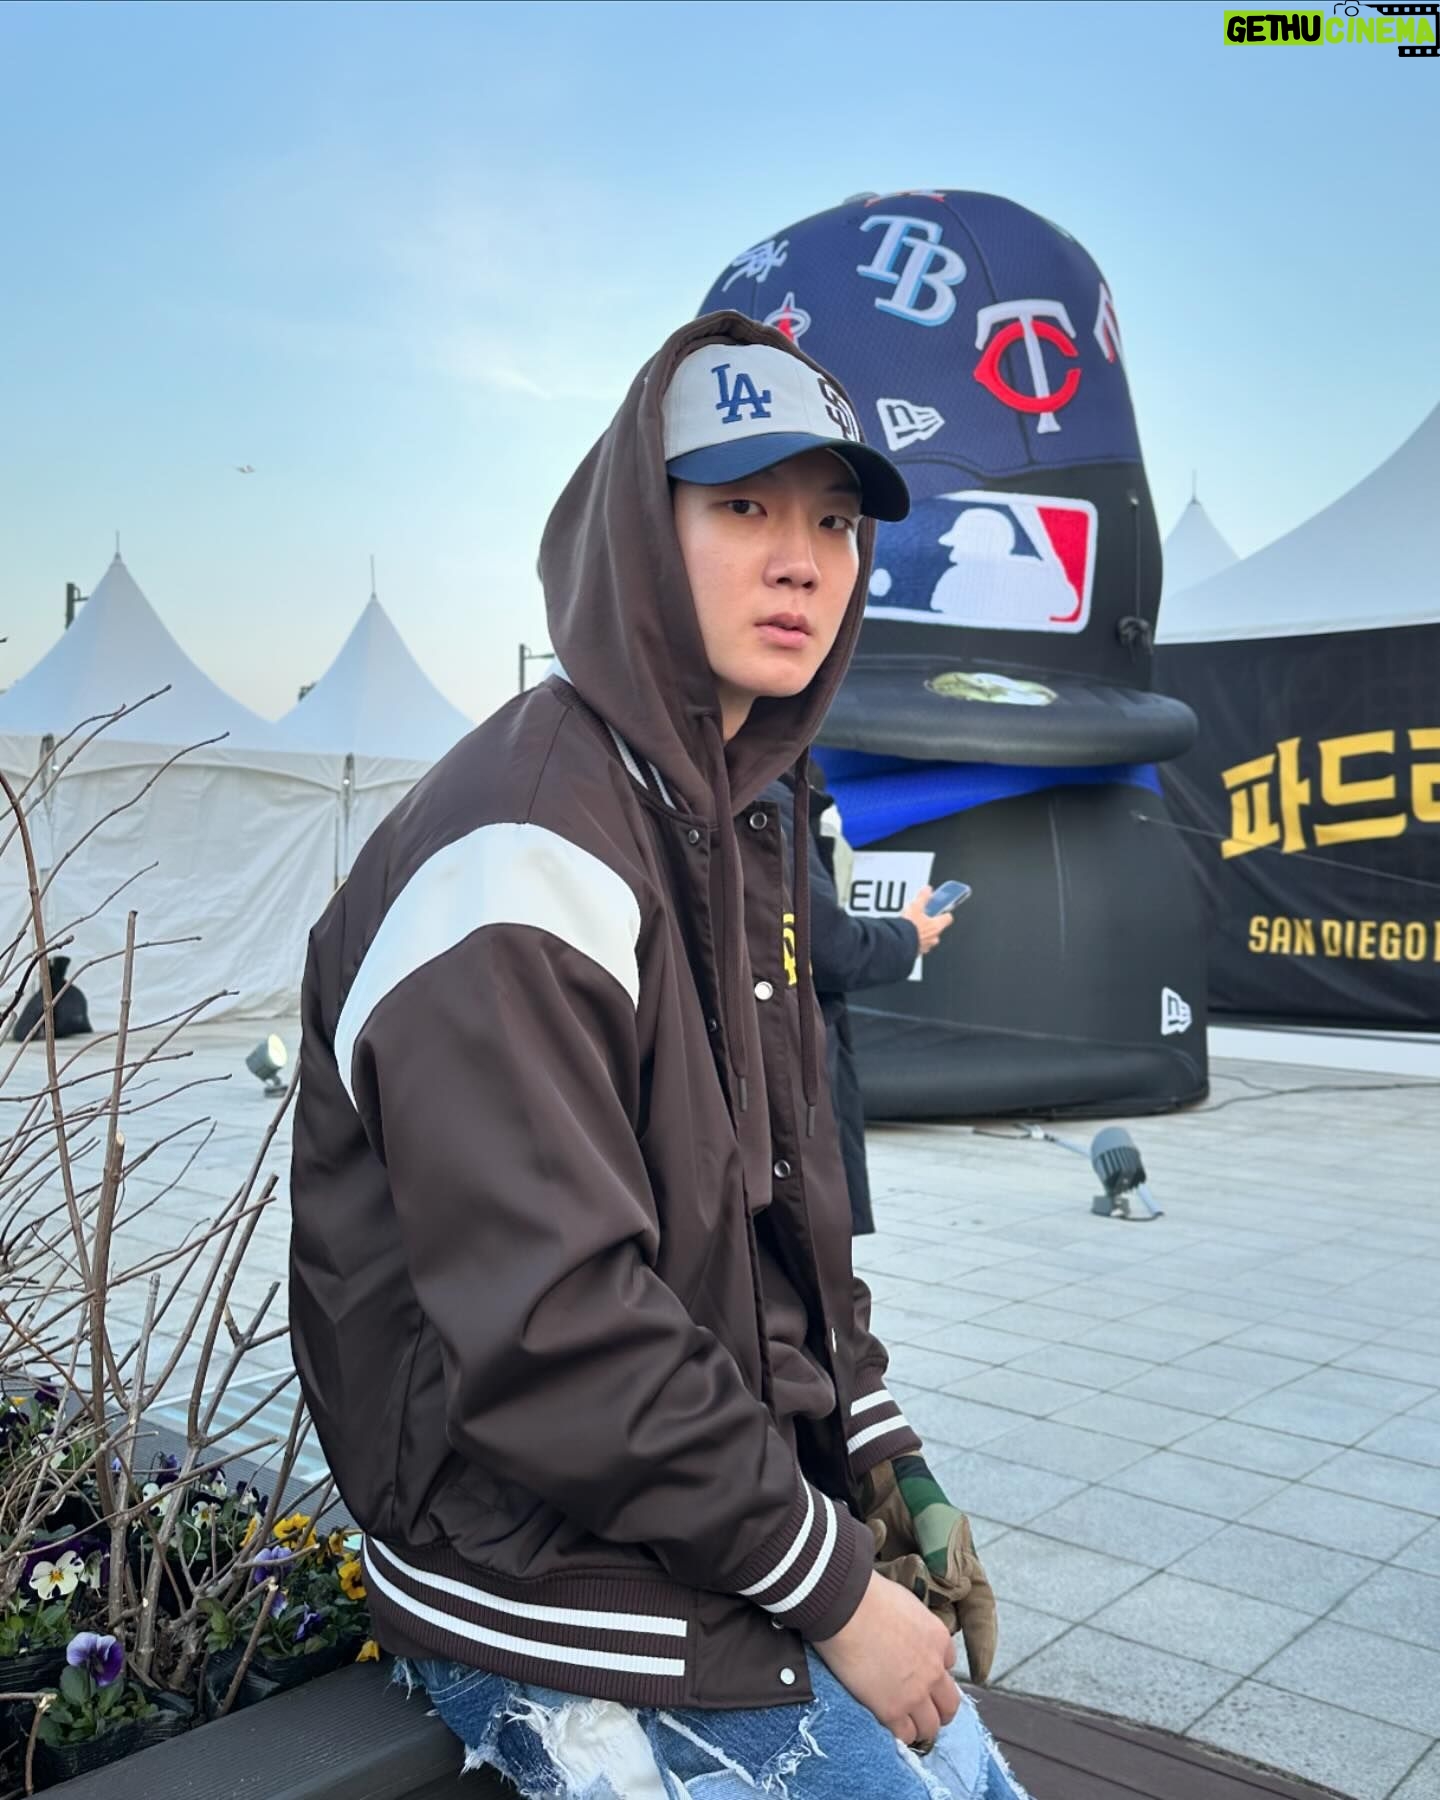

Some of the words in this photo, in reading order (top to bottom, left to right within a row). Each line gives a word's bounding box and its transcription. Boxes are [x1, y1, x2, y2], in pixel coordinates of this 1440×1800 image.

[856, 214, 966, 327] TB
[711, 363, 772, 424] LA
[1248, 915, 1316, 956] SAN
[1322, 919, 1426, 961] DIEGO
